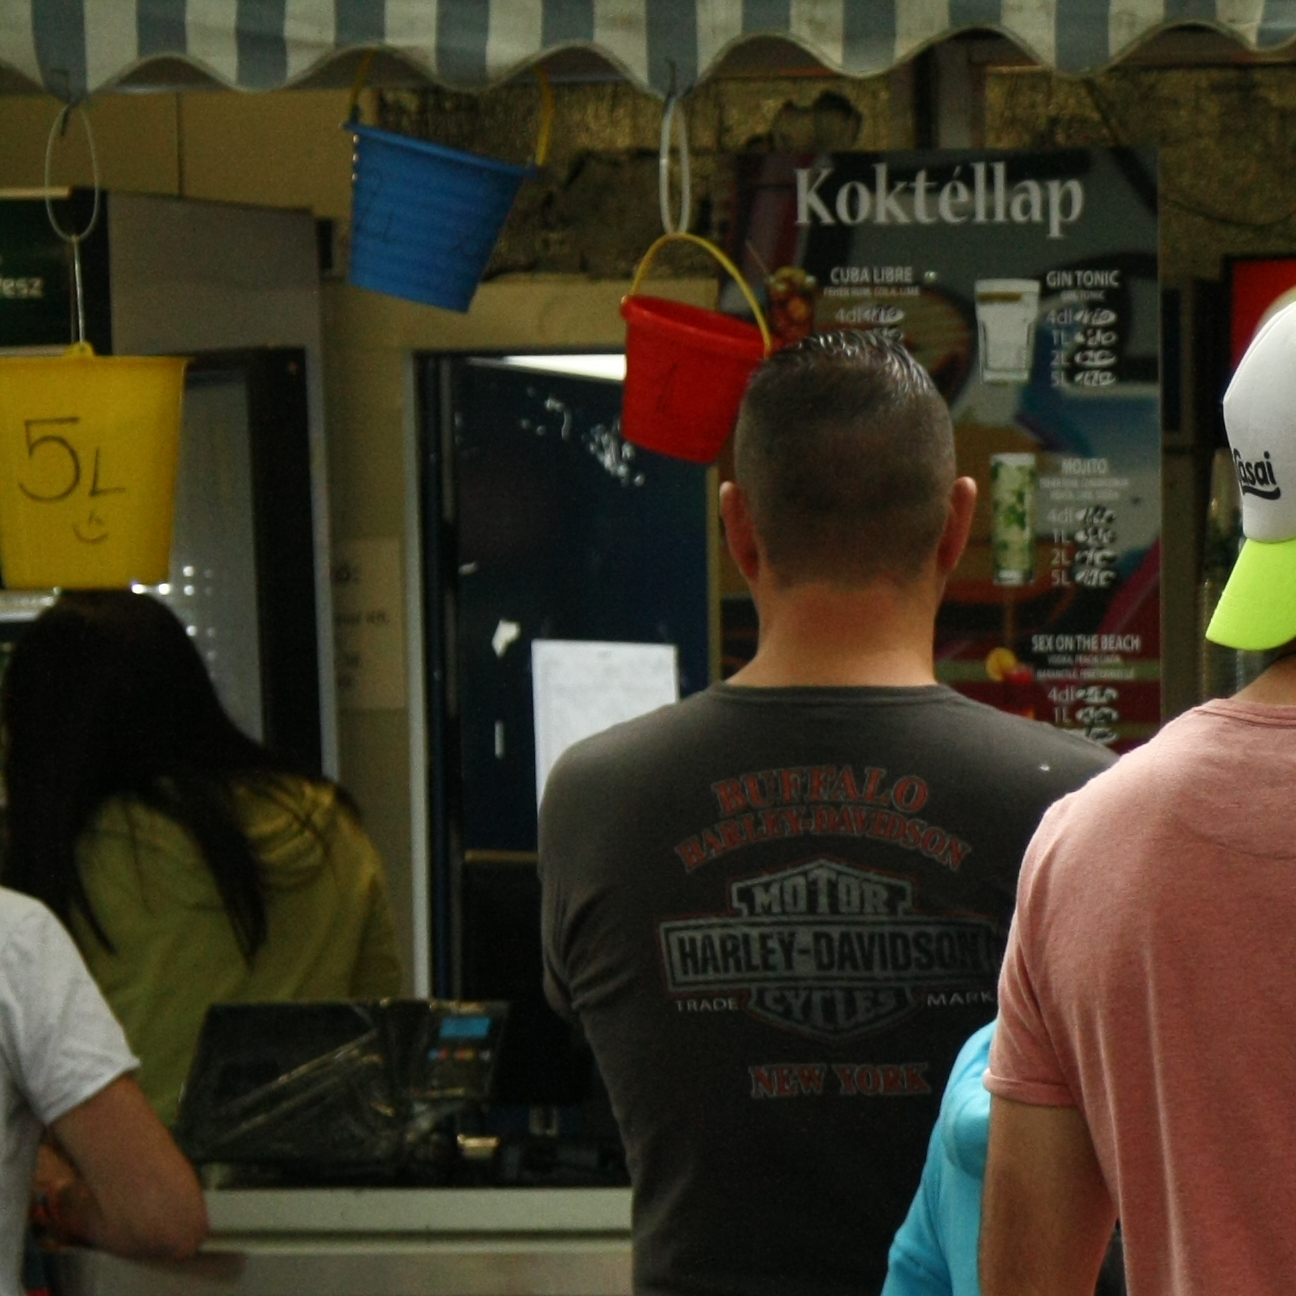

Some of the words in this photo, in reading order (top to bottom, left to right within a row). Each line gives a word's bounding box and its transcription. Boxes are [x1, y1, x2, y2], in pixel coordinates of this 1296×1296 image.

[795, 161, 1084, 239] Koktéllap
[830, 266, 870, 285] CUBA
[873, 266, 912, 284] LIBRE
[1046, 270, 1072, 288] GIN
[1074, 270, 1120, 288] TONIC
[1062, 458, 1108, 474] MOJITO
[1031, 634, 1054, 653] SEX
[1056, 634, 1074, 652] ON
[1075, 634, 1099, 652] THE
[1101, 634, 1141, 652] BEACH
[711, 765, 930, 817] BUFFALO
[674, 804, 972, 872] HARLEY-DAVIDSON
[752, 868, 889, 915] MOTOR
[677, 930, 990, 977] HARLEY-DAVIDSON
[675, 997, 740, 1013] TRADE
[926, 990, 998, 1008] MARK
[748, 1062, 828, 1098] NEW
[832, 1061, 931, 1097] YORK
